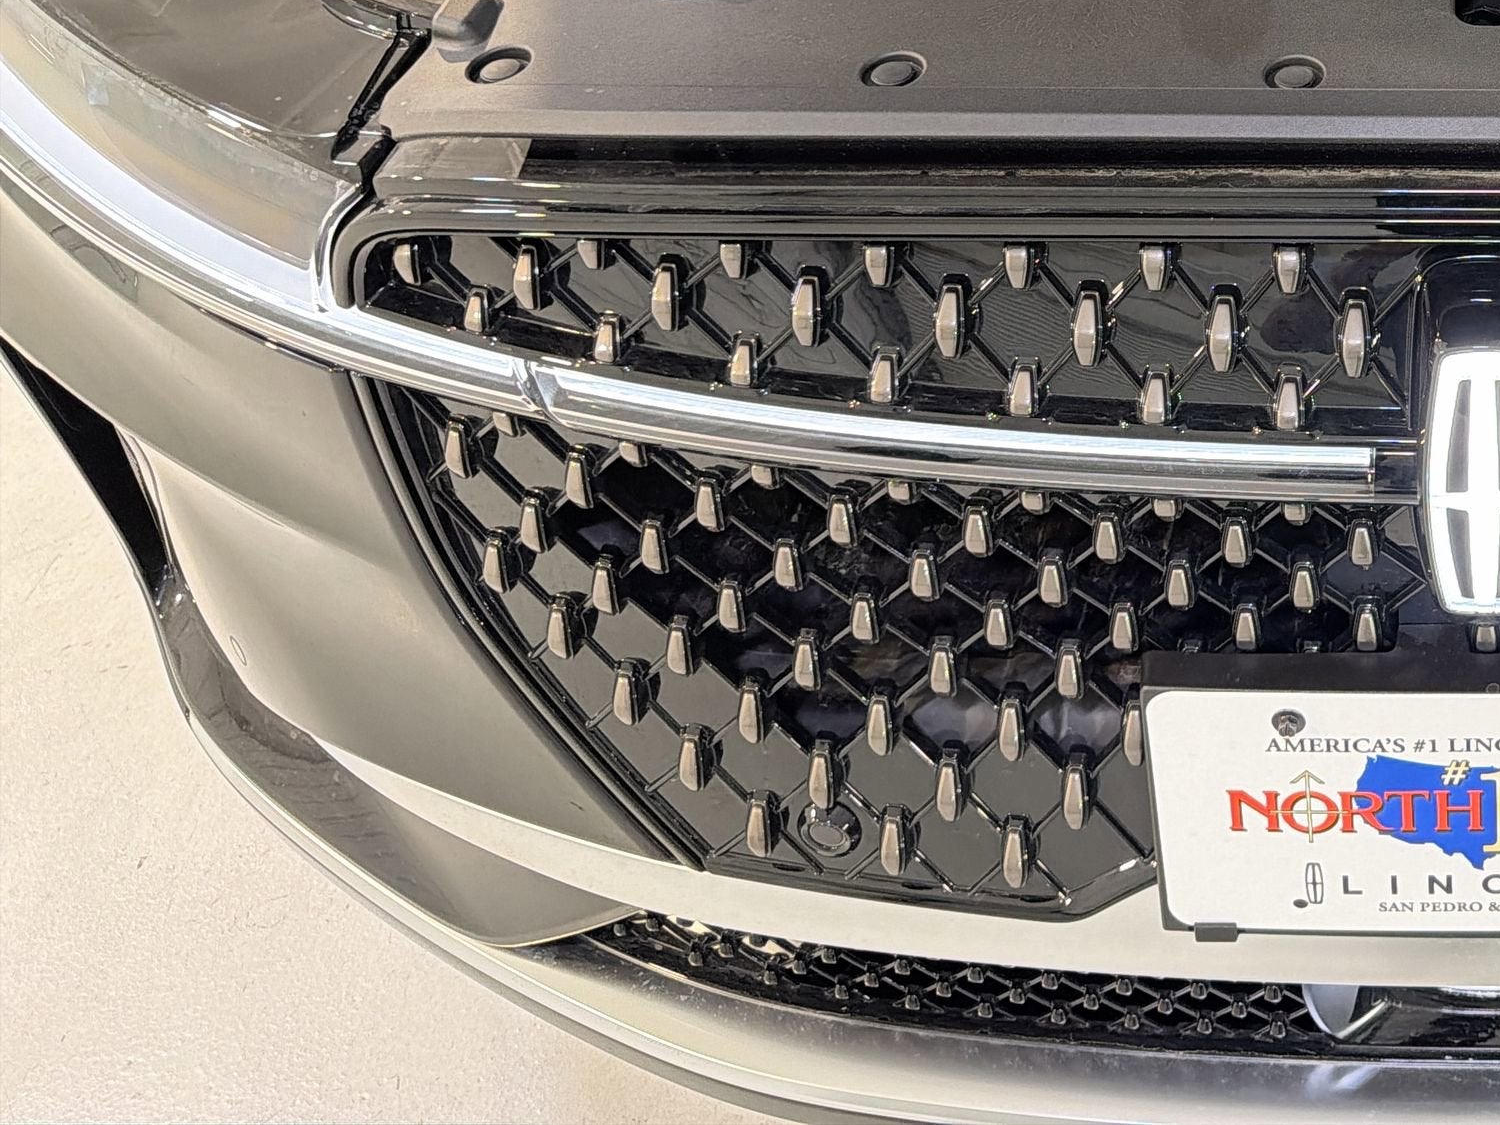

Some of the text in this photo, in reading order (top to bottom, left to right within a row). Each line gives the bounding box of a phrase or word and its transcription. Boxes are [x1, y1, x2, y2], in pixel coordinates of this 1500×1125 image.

[1265, 737, 1405, 753] AMERICA'S
[1413, 738, 1439, 753] #1
[1226, 789, 1485, 834] NORTH
[1378, 901, 1415, 913] SAN
[1420, 901, 1483, 913] PEDRO
